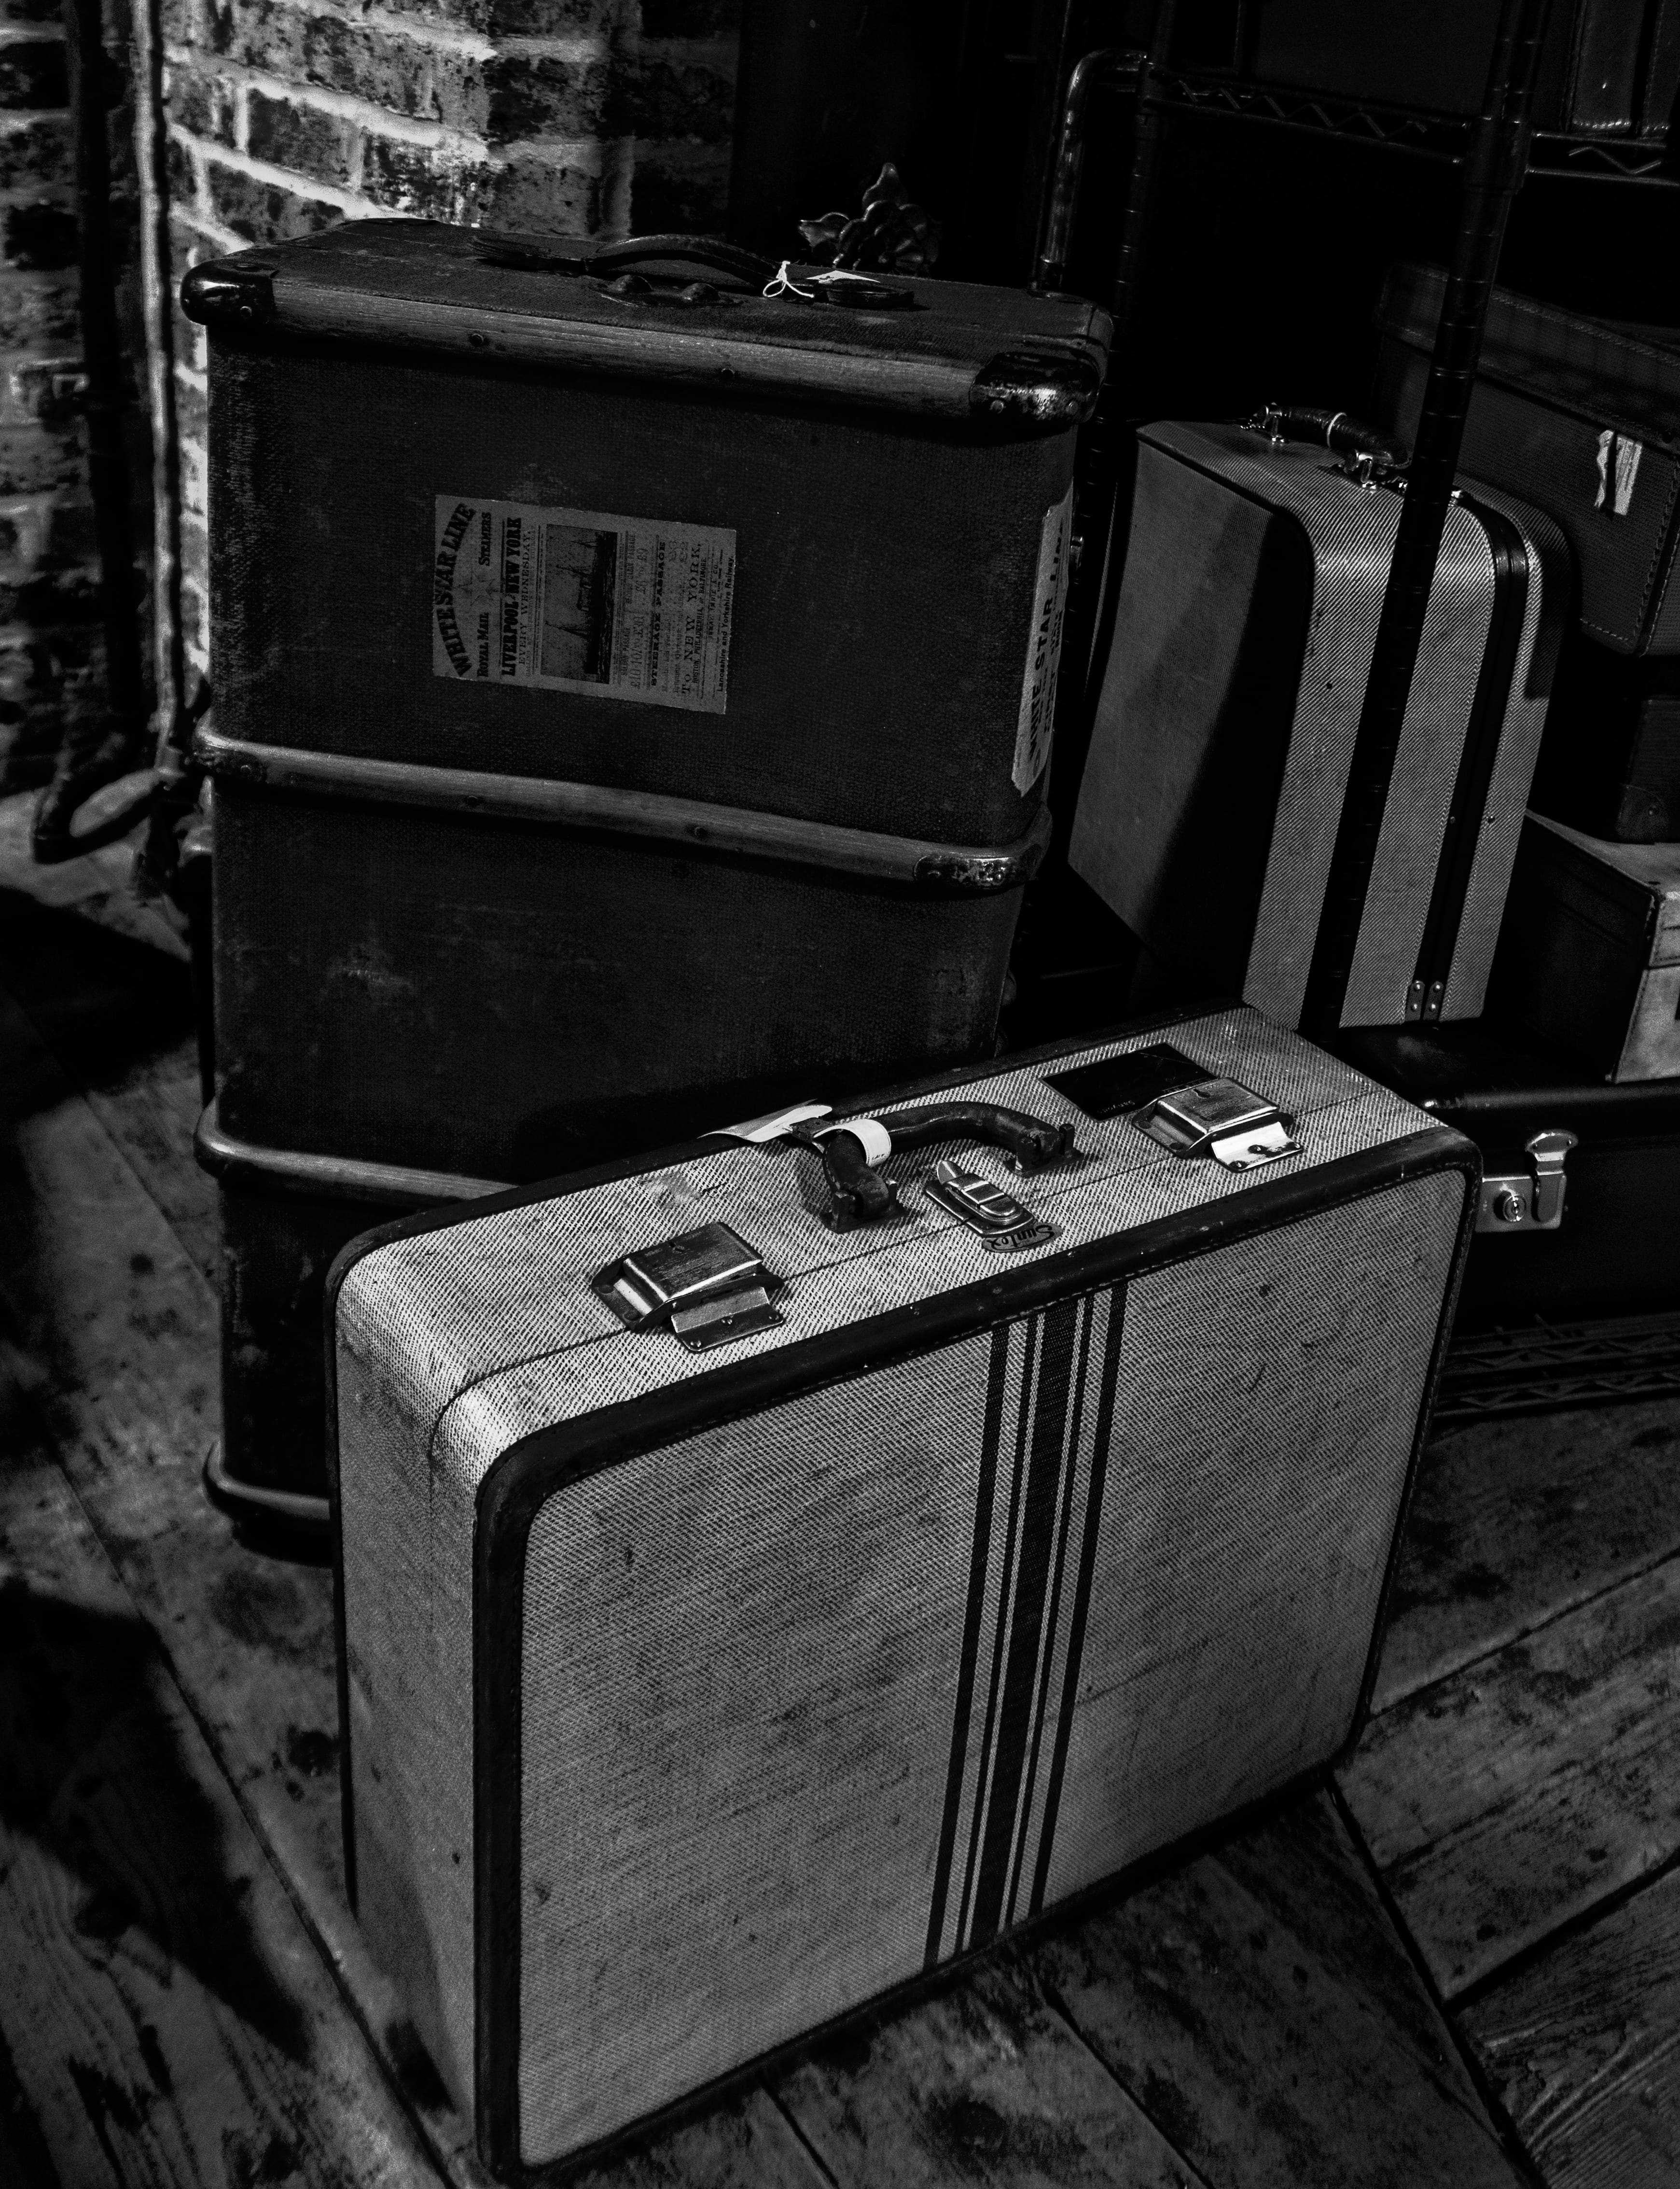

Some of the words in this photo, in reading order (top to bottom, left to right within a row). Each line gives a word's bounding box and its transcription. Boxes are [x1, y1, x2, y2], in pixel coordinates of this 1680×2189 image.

[441, 503, 476, 551] LINE
[478, 510, 491, 566] STEAMERS
[505, 516, 521, 558] YORK
[434, 551, 457, 605] STAR
[505, 559, 520, 594] NEW
[521, 530, 530, 615] WEDNESDAY,
[655, 541, 665, 606] PASSAGE
[725, 555, 734, 588] Railway.
[477, 611, 489, 641] MAIL
[722, 591, 731, 628] Yorkshire
[436, 607, 472, 675] WHITE
[476, 641, 489, 677] ROYAL
[501, 600, 518, 676] LIVERPOOL
[651, 612, 661, 686] STEERAGE
[684, 615, 694, 661] NEW
[681, 673, 691, 694] To
[717, 648, 725, 692] Lancashire
[1029, 679, 1041, 760] WHITE
[1035, 598, 1053, 670] STAR
